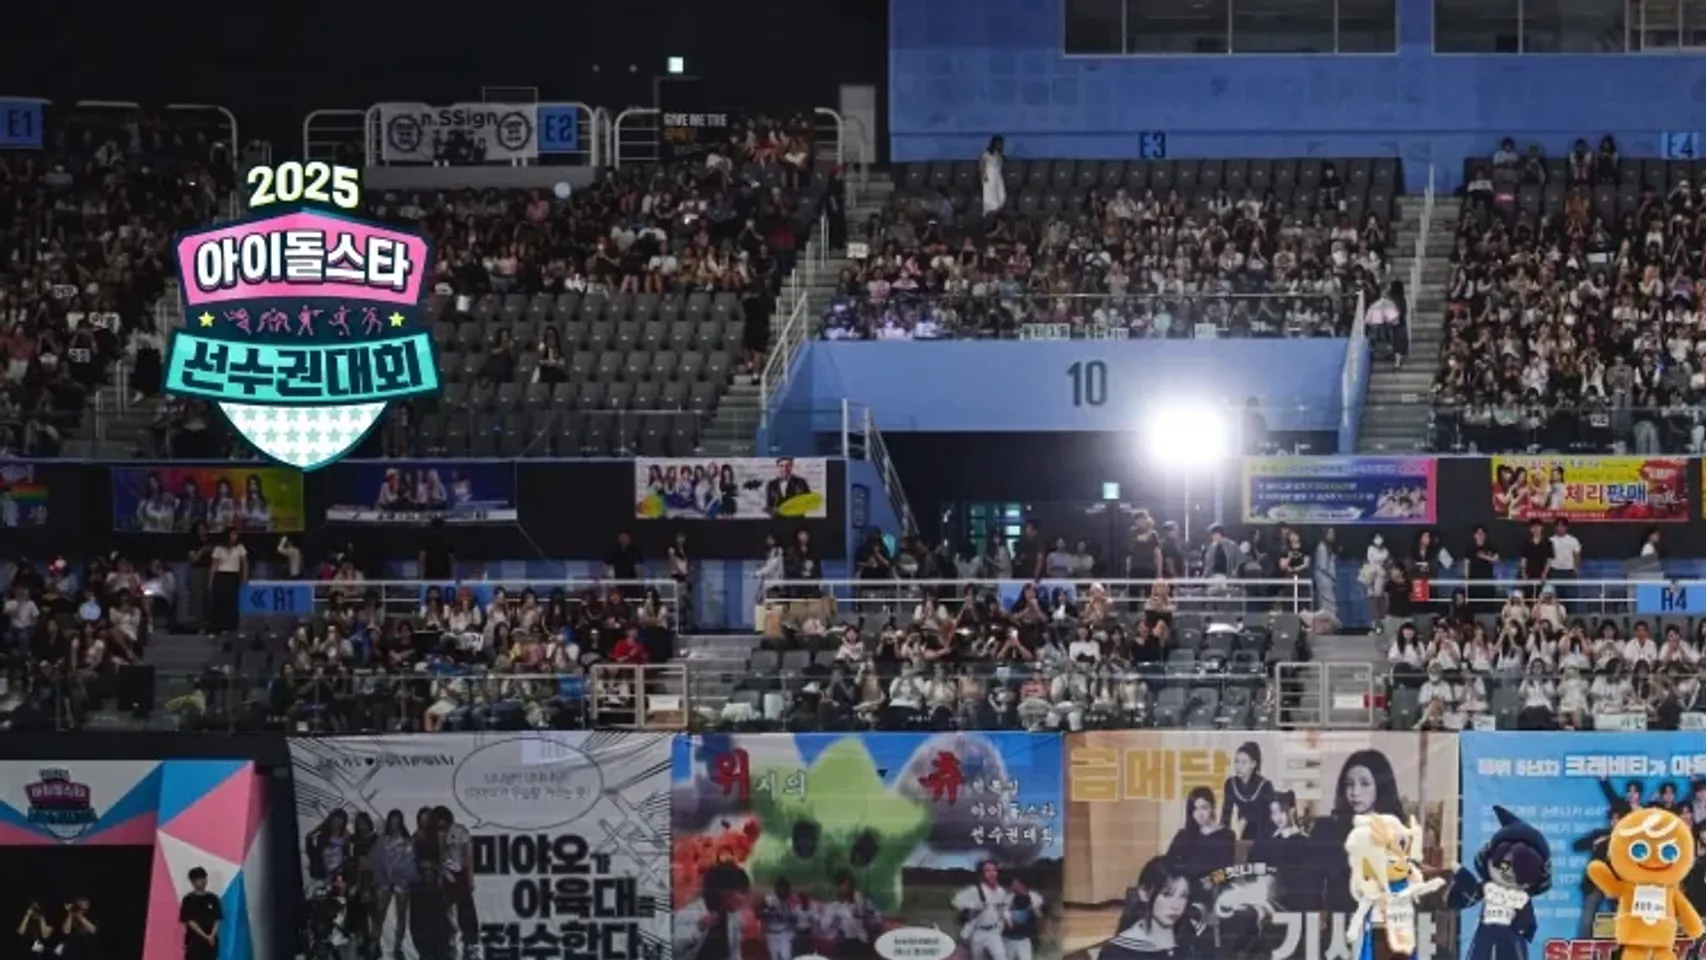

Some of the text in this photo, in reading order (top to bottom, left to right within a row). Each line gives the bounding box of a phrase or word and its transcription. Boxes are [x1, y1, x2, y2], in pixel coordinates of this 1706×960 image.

[8, 109, 32, 138] E1
[545, 114, 574, 143] E2
[1139, 132, 1166, 158] E3
[1668, 132, 1693, 158] E4
[1066, 360, 1109, 408] 10
